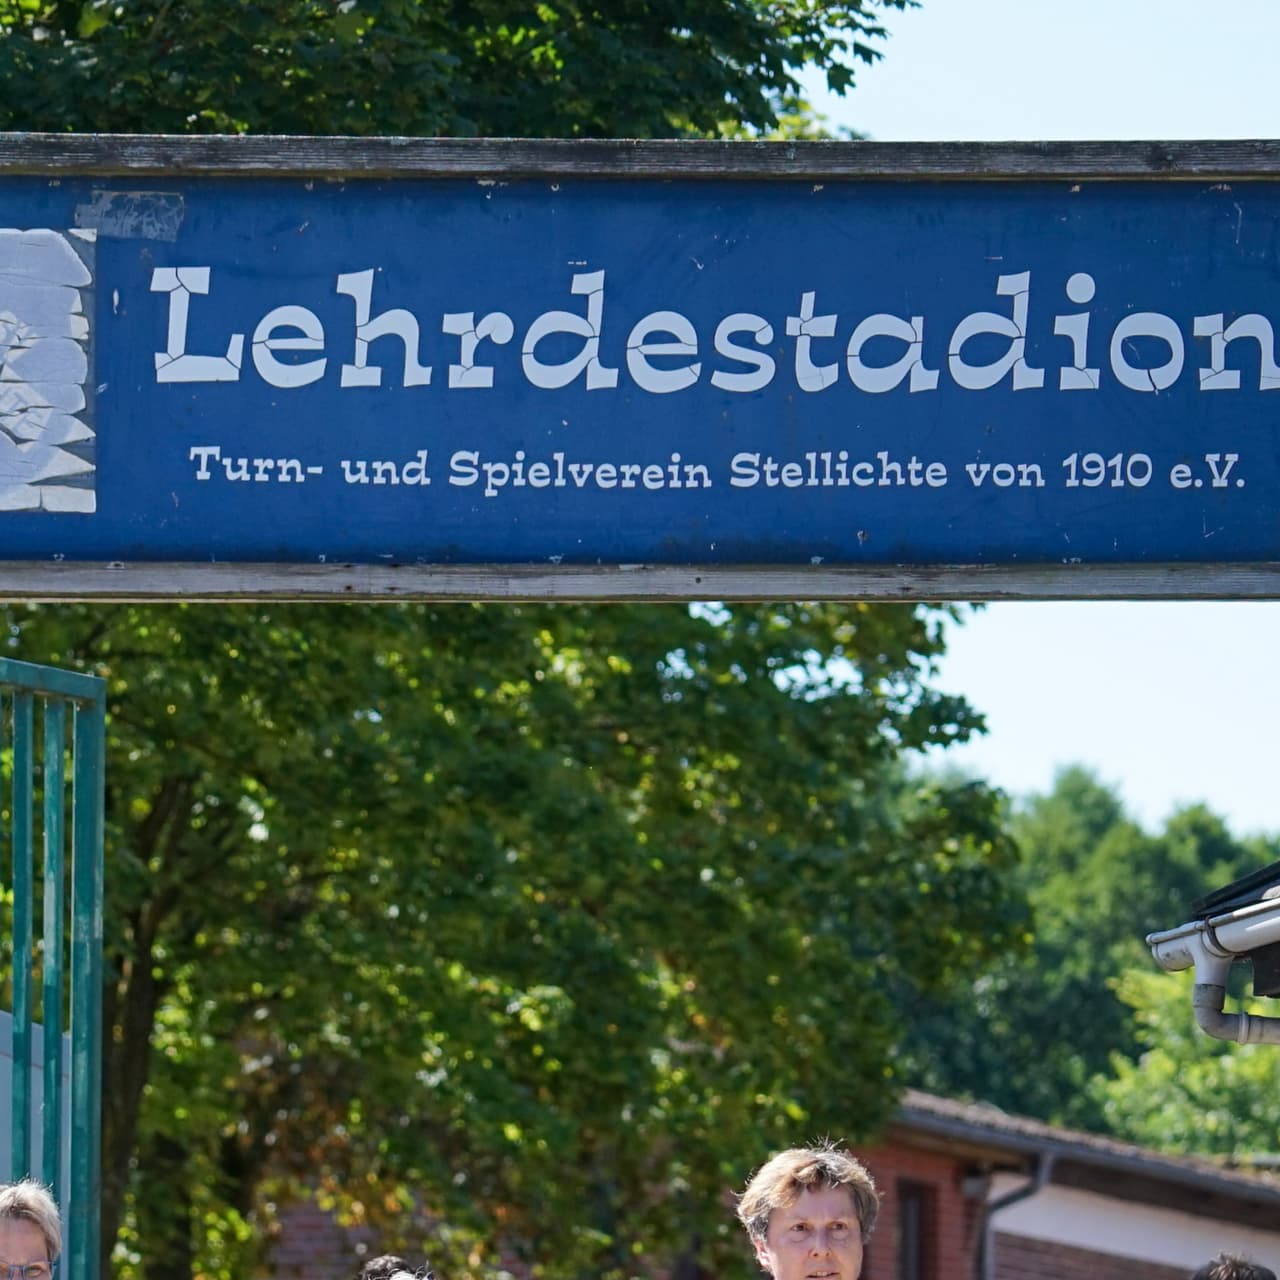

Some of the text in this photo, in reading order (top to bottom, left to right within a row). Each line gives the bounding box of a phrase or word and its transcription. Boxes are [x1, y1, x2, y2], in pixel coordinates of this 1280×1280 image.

[189, 446, 1246, 497] Turn- und Spielverein Stellichte von 1910 e.V.
